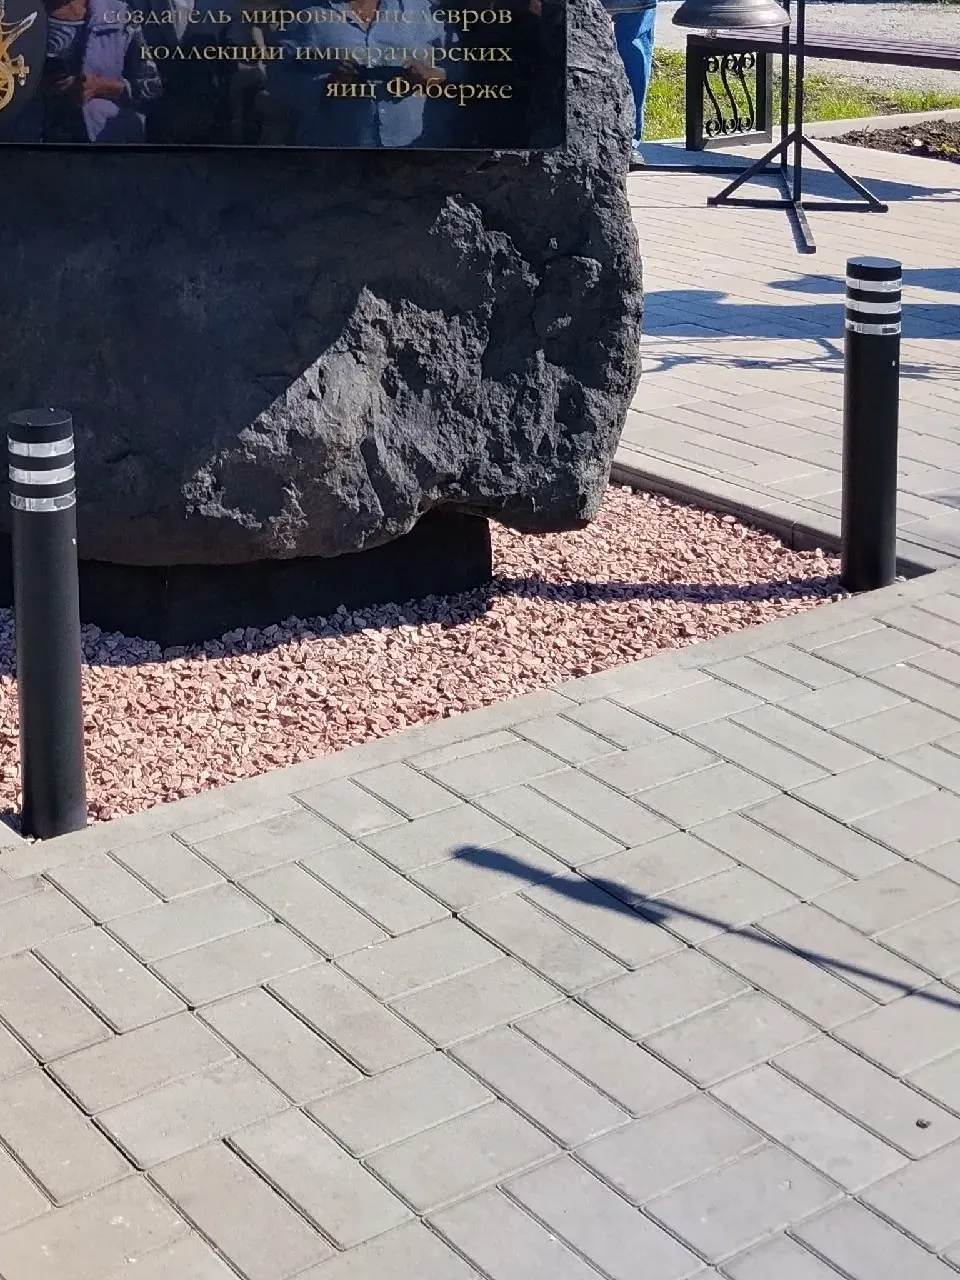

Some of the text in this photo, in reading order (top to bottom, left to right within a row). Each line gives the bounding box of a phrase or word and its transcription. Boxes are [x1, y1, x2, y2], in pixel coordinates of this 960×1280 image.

[241, 8, 368, 32] мировых
[140, 45, 513, 69] коллекции императорских
[326, 77, 513, 106] яиц Фаберже
